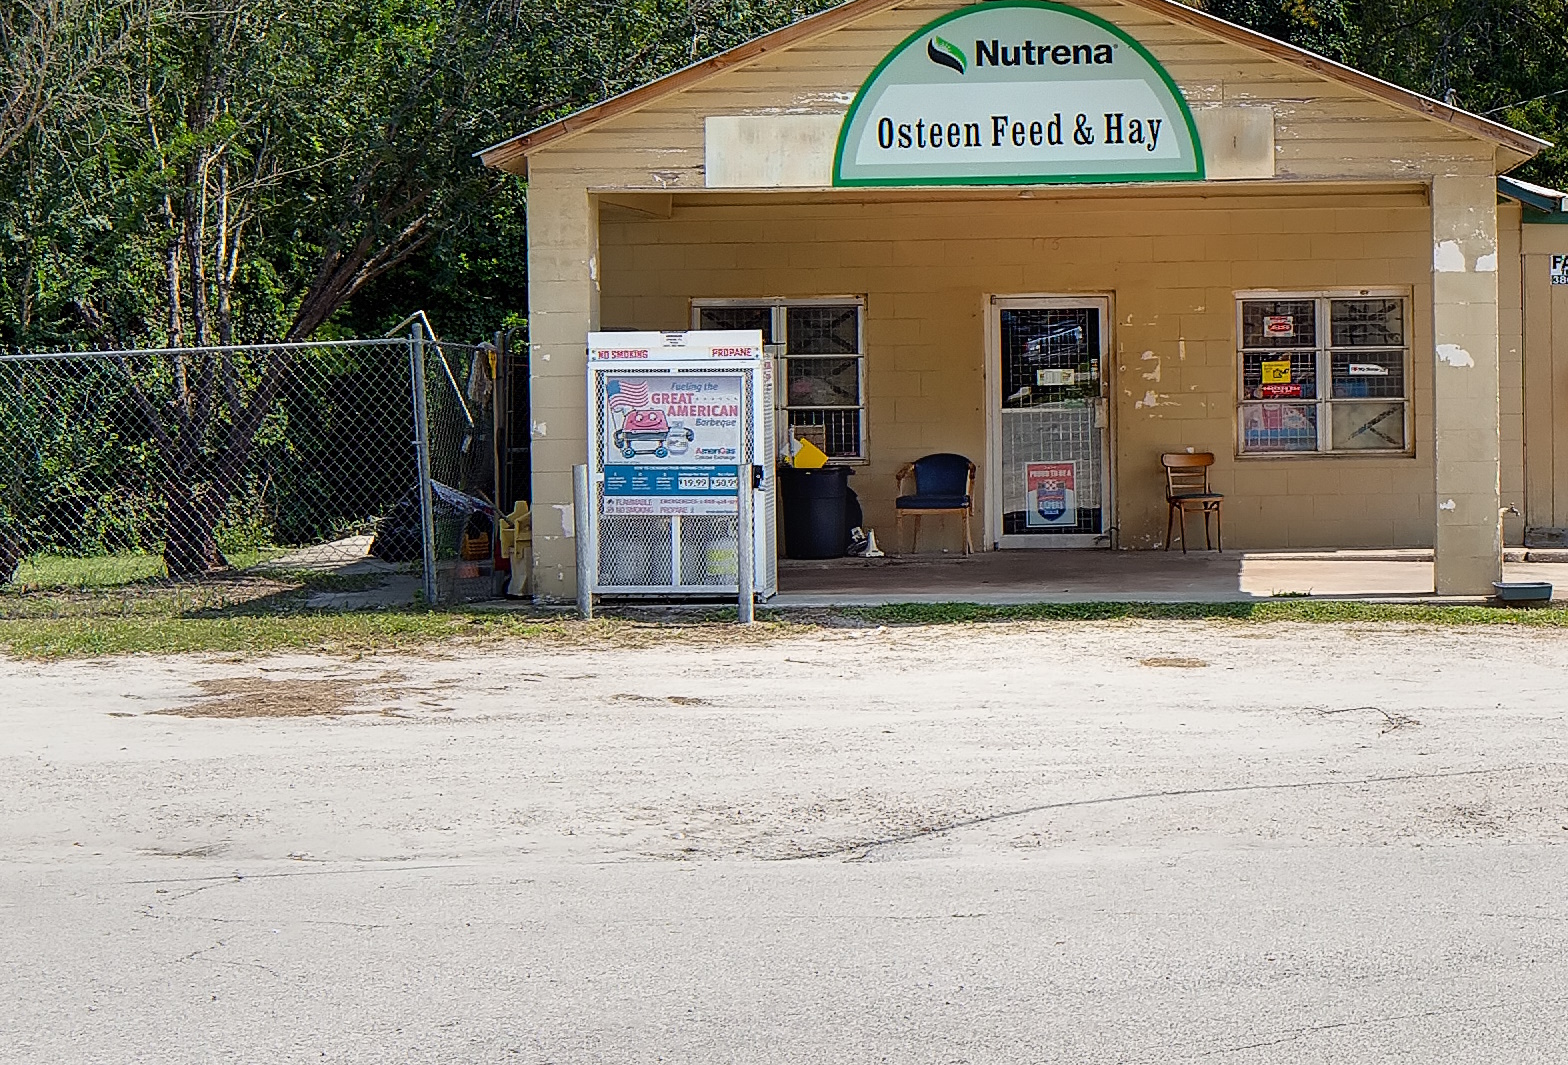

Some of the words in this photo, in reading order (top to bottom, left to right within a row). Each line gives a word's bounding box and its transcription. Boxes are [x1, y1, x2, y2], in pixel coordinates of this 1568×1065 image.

[975, 39, 1113, 67] Nutrena
[877, 117, 982, 149] Osteen
[991, 113, 1063, 147] Feed
[1073, 113, 1095, 145] &
[1104, 113, 1163, 151] Hay
[597, 350, 609, 359] NO
[611, 349, 649, 359] SMOKING
[711, 347, 753, 357] PROPANE
[671, 383, 702, 392] Fueling
[704, 382, 718, 390] the
[651, 392, 695, 404] GREAT
[667, 405, 738, 417] AMERICAN
[695, 418, 736, 427] Barbeque
